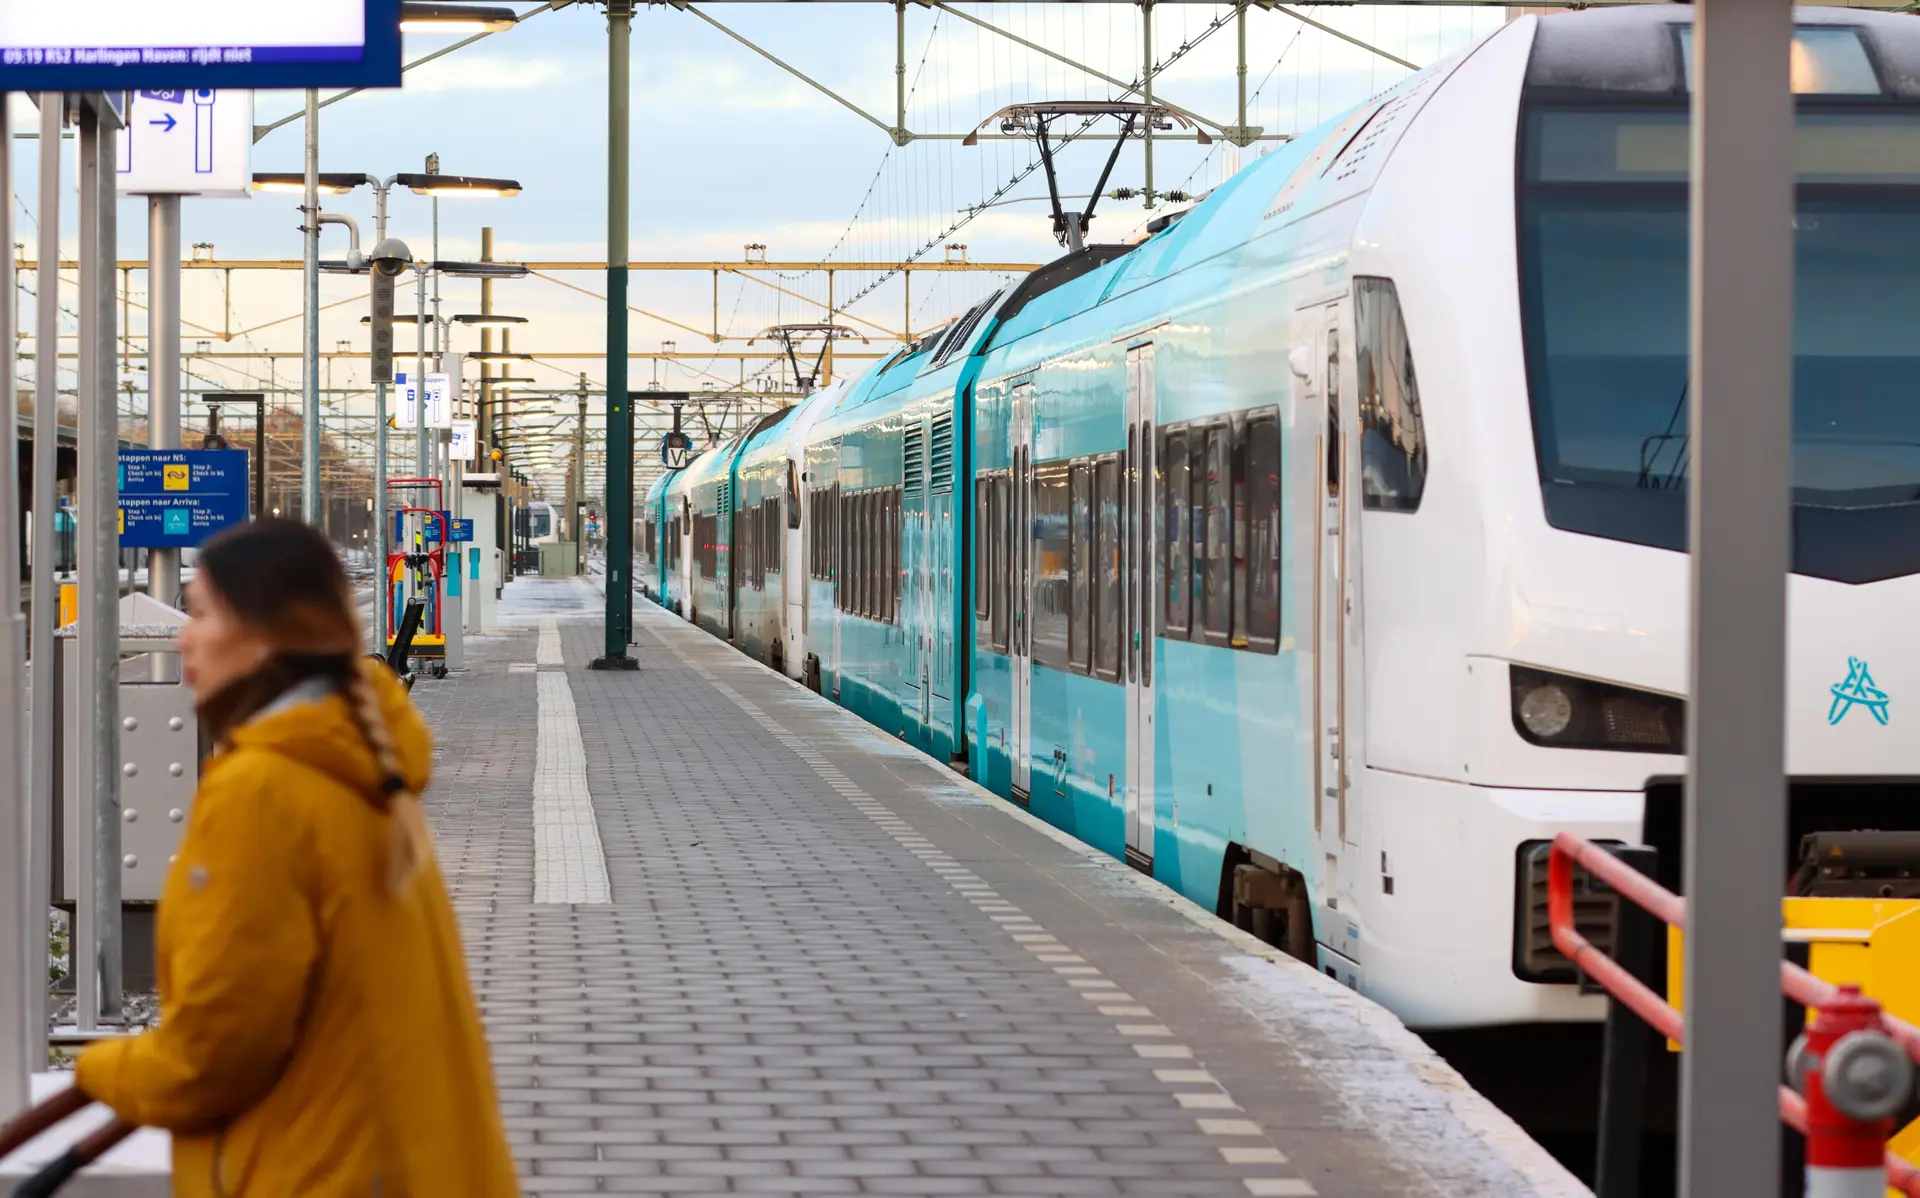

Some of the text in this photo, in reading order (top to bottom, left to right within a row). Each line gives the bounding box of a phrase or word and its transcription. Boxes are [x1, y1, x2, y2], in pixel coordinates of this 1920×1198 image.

[75, 48, 140, 66] Harlingen
[223, 47, 252, 64] niet
[118, 454, 150, 463] stappen
[670, 449, 683, 466] V
[118, 498, 150, 507] stappen
[173, 498, 200, 506] Arriva:
